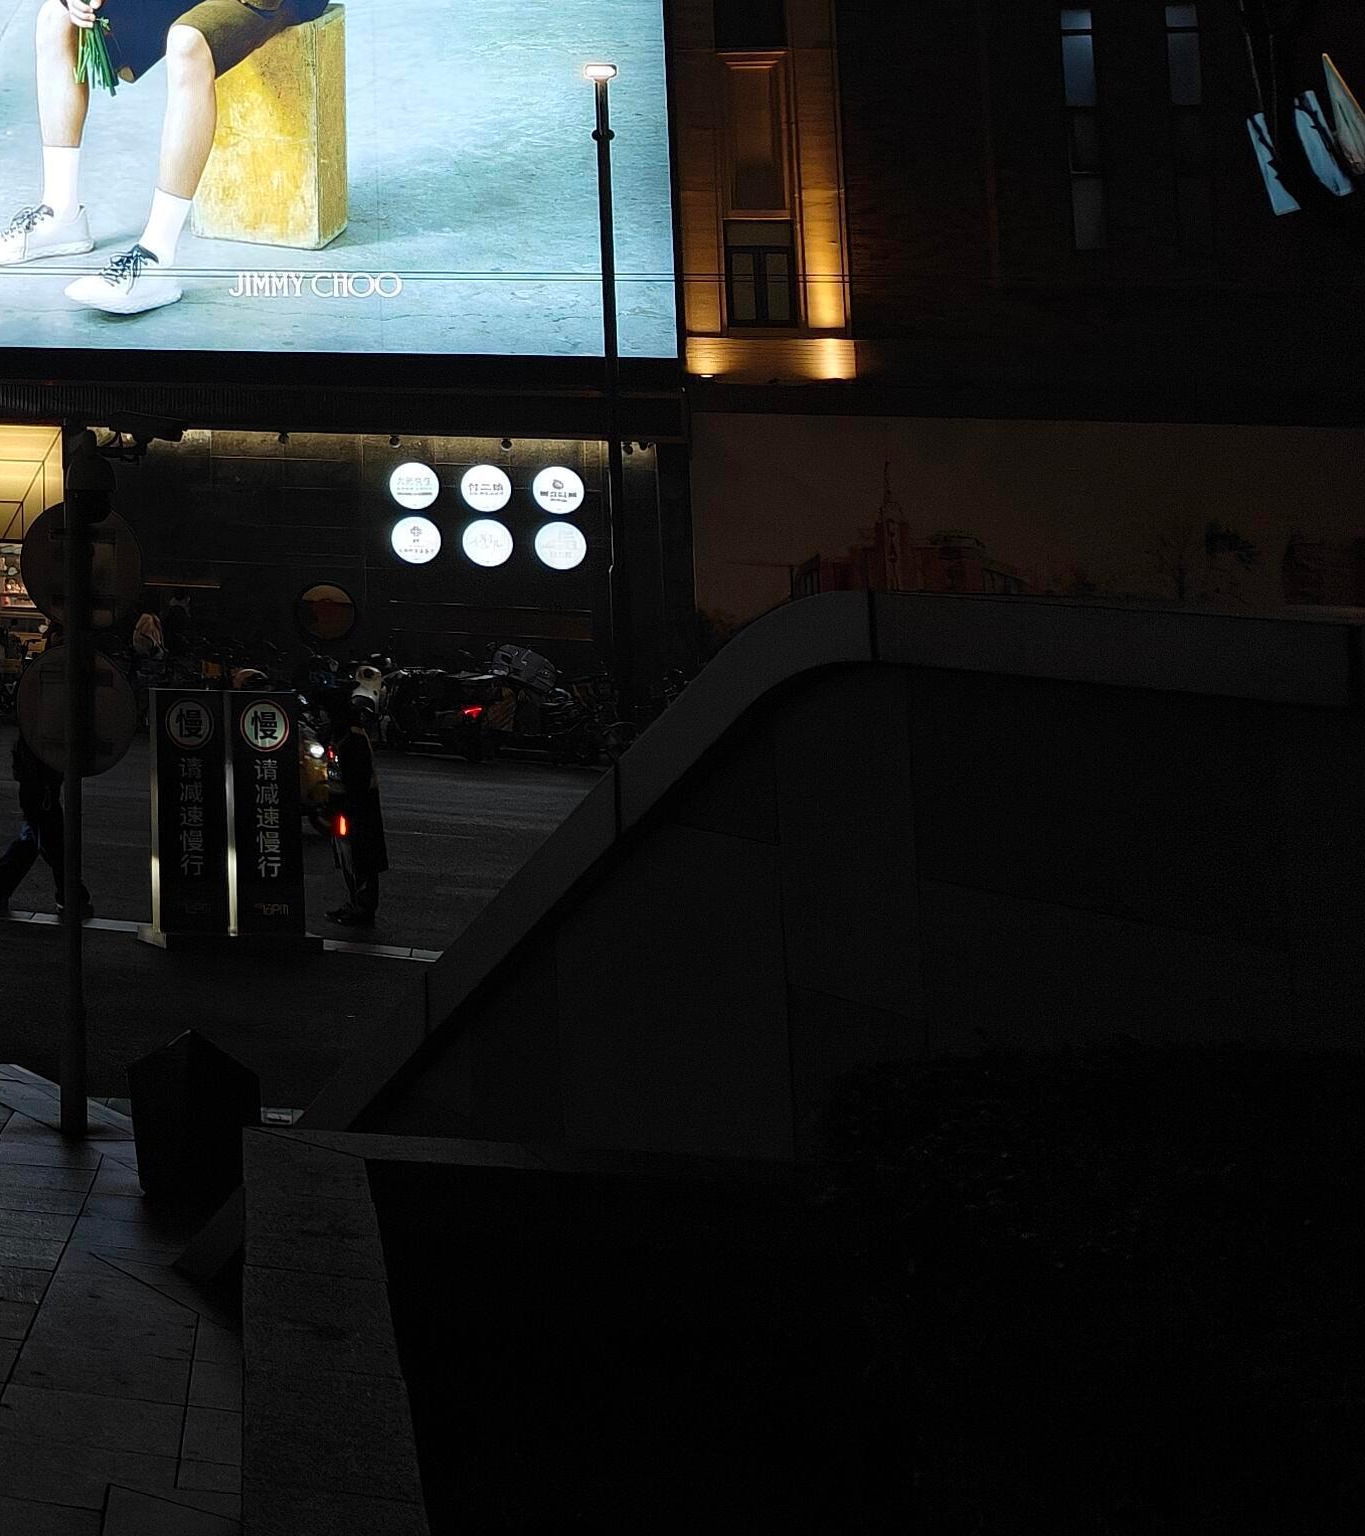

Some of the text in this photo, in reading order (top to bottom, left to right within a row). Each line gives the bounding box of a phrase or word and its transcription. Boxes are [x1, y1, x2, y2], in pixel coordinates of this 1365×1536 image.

[228, 271, 403, 299] JIMMY CHOO
[176, 707, 202, 739] 慢
[251, 711, 278, 740] 慢
[178, 756, 205, 877] 请减速慢行
[253, 758, 282, 879] 请减速慢行
